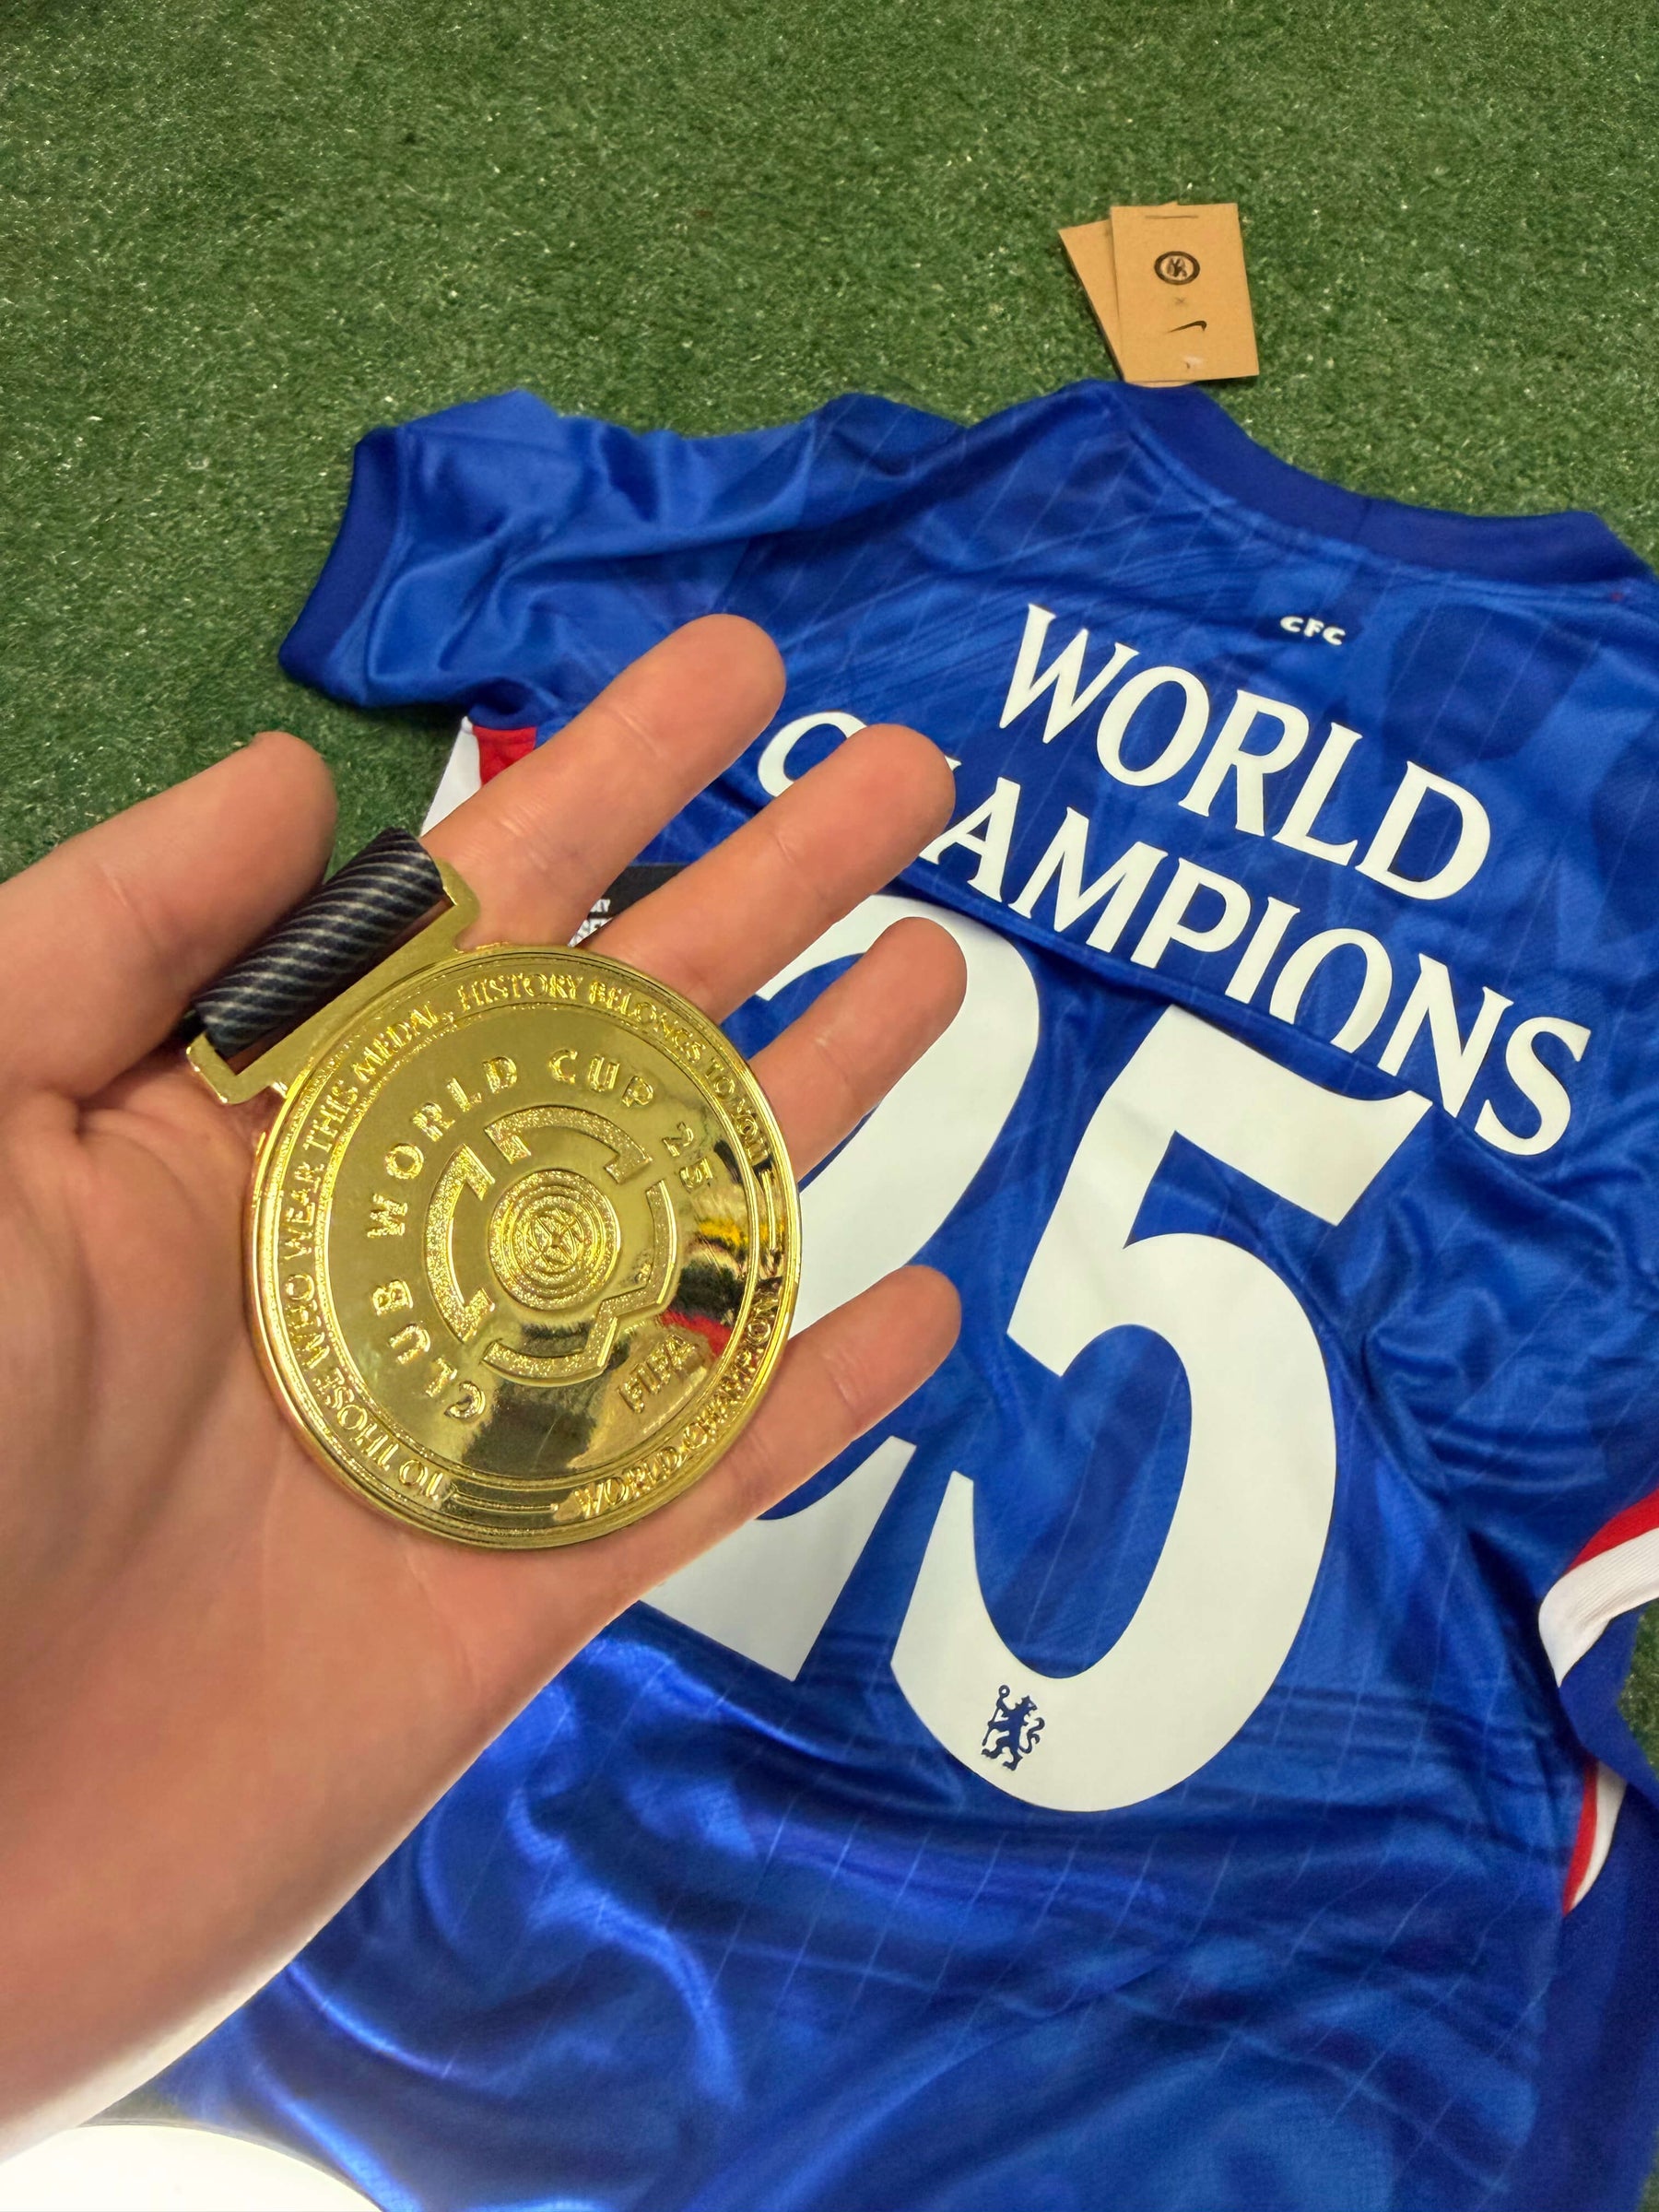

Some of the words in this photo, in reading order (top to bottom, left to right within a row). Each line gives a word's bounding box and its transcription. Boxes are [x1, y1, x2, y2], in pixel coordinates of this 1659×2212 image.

[1279, 616, 1347, 646] CFC
[998, 604, 1491, 900] WORLD
[758, 711, 1592, 1156] CAMPIONS
[457, 972, 584, 1013] HISTORY
[588, 980, 707, 1064] BELONGS
[302, 1079, 359, 1153] THIS
[548, 1049, 655, 1108] CUP
[704, 1057, 736, 1101] TO
[367, 1055, 518, 1240] WORLD
[662, 1121, 714, 1194] 25
[283, 1161, 324, 1261] WEAR
[284, 1273, 331, 1370] WHO
[371, 1278, 487, 1419] CLUB
[618, 1334, 697, 1414] FIFA
[312, 1367, 399, 1473] THOSE
[573, 1444, 682, 1519] WORLD
